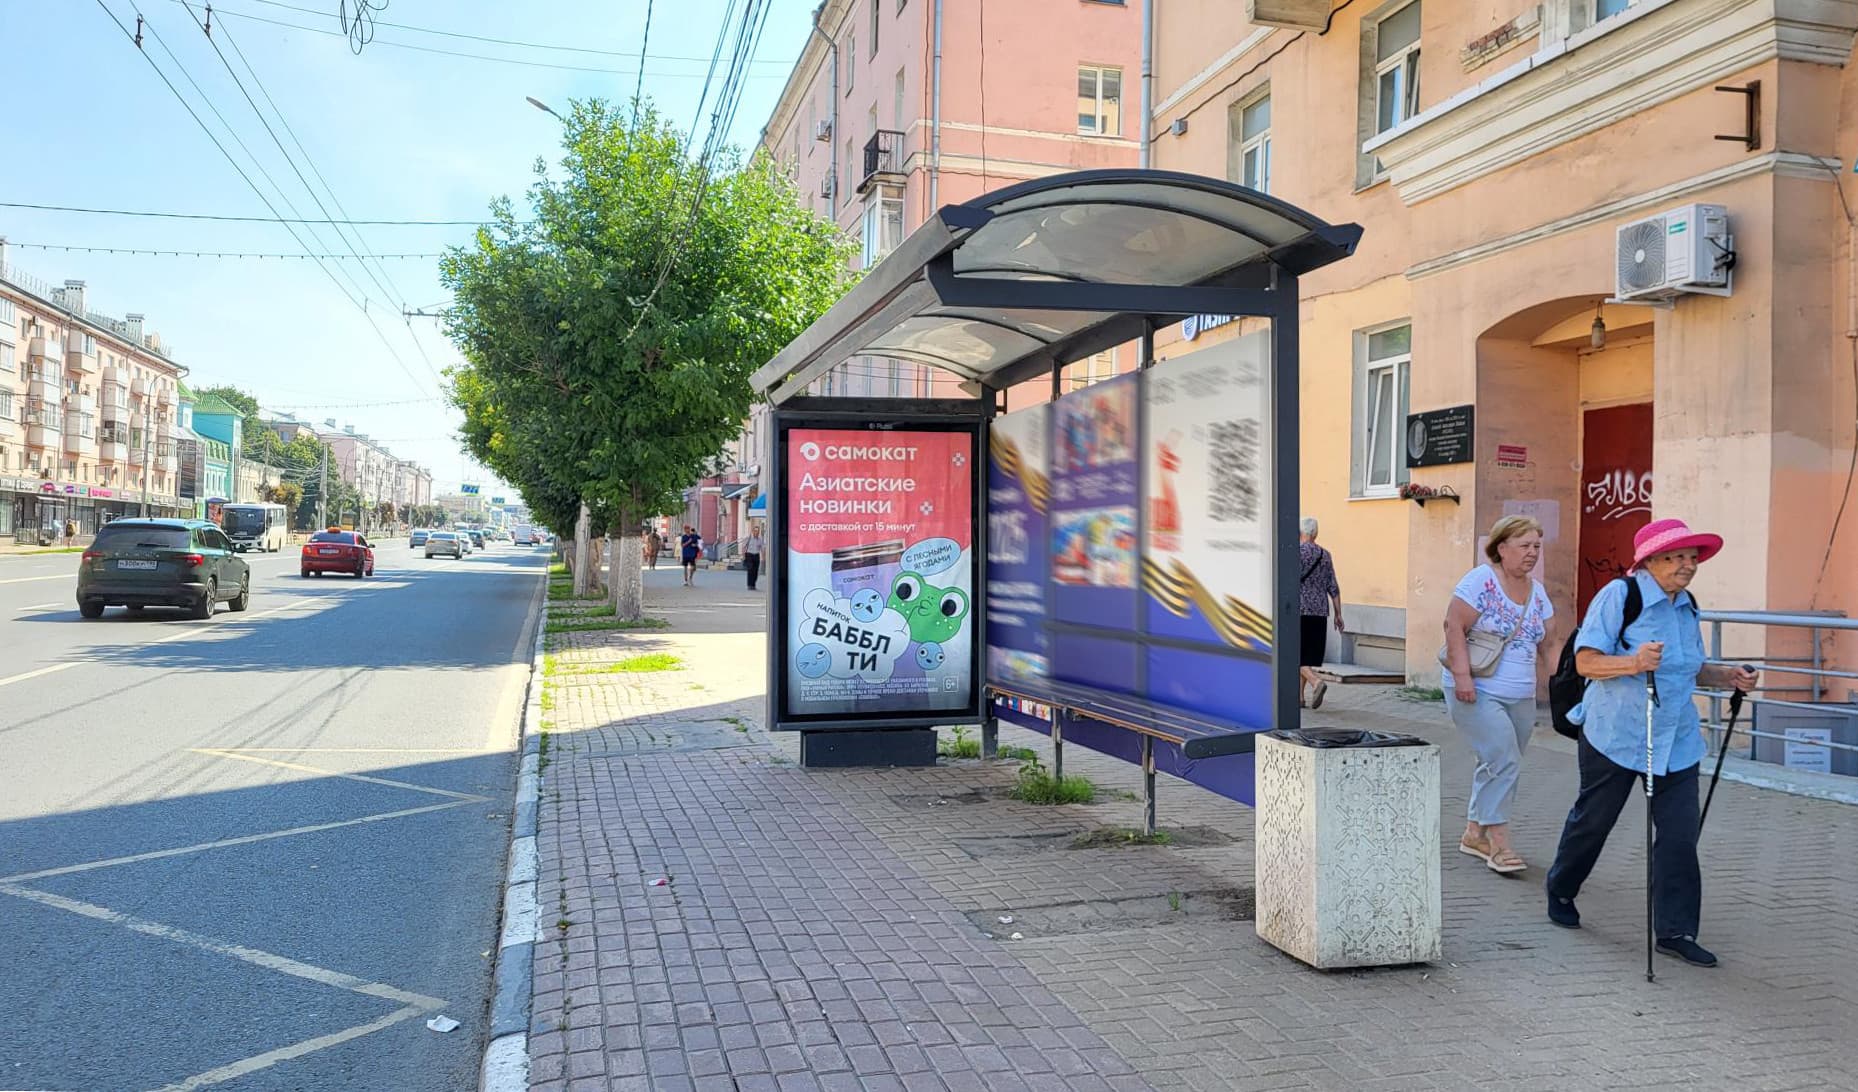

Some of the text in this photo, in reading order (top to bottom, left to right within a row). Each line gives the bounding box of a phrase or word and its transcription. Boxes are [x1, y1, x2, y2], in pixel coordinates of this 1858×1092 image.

[824, 445, 918, 461] самокат
[799, 472, 916, 492] Азиатские
[799, 499, 892, 514] новинки
[808, 521, 861, 533] доставкой
[875, 521, 885, 531] 15
[886, 524, 916, 534] минут
[905, 544, 953, 564] С ЛЕСНЫМИ
[914, 555, 951, 571] ЯГОДАМИ
[843, 574, 875, 584] самокат
[816, 601, 851, 624] НАПИТОК
[812, 617, 891, 655] БАББЛ
[846, 651, 877, 672] ТИ
[945, 679, 956, 690] 6+
